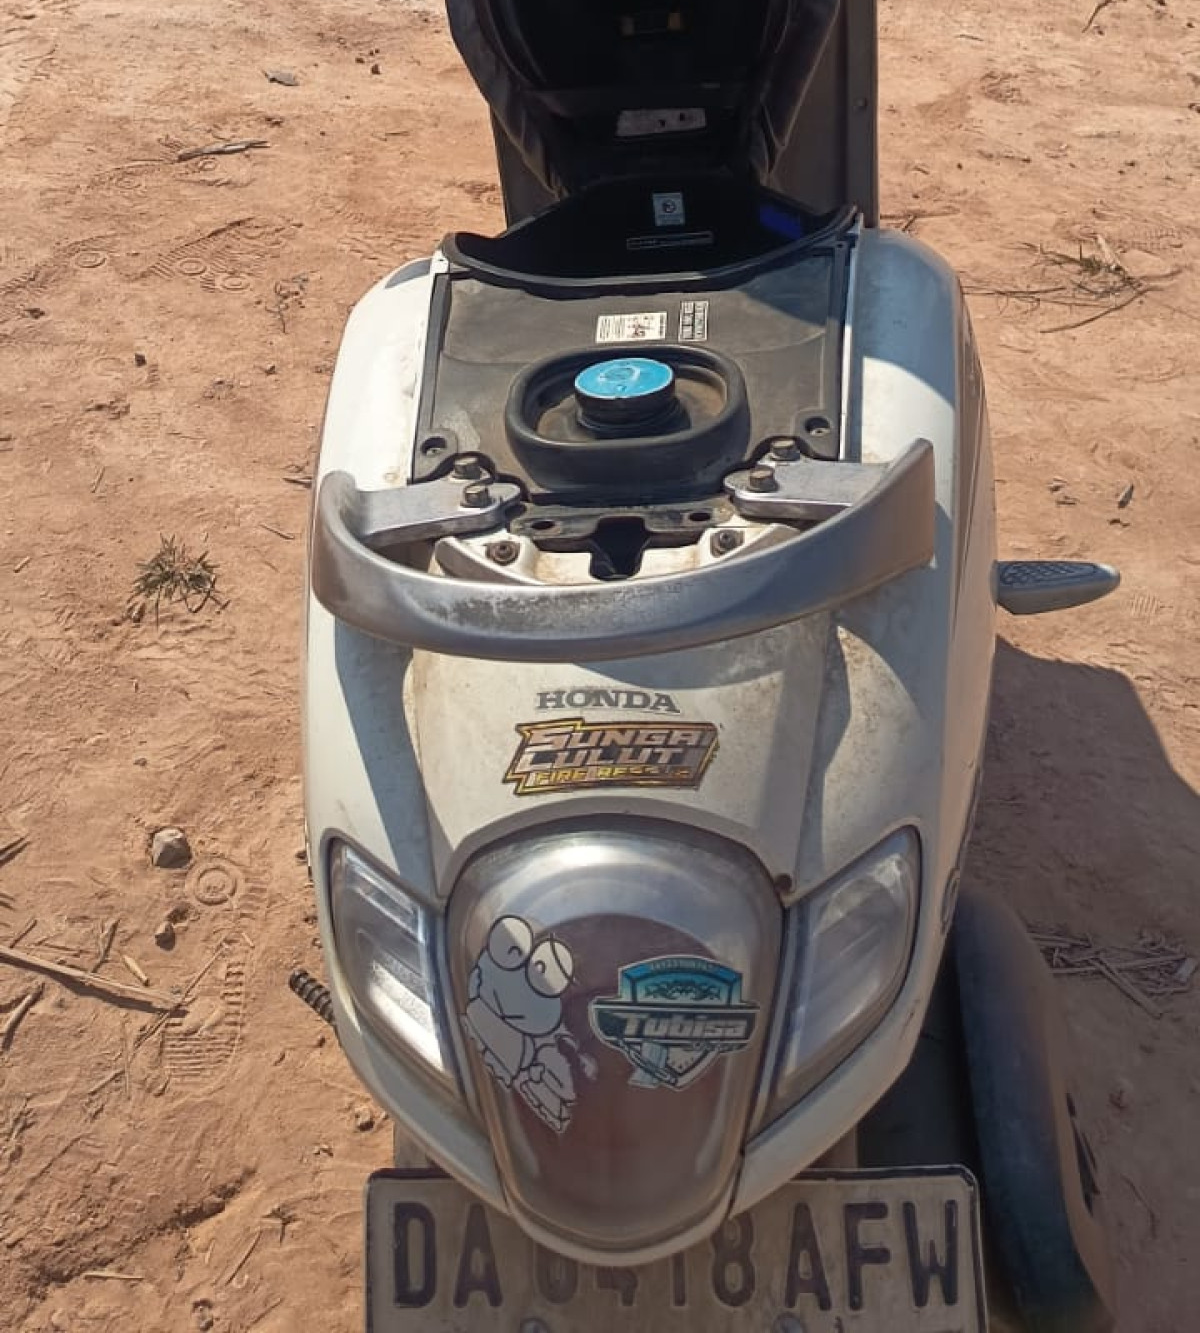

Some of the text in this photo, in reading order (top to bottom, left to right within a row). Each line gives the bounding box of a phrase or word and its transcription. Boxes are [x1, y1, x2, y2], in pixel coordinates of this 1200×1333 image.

[536, 689, 681, 713] HONDA
[533, 768, 590, 786] FIRE
[612, 1012, 749, 1039] Tubisa
[394, 1202, 504, 1308] DA
[784, 1199, 958, 1312] AFW
